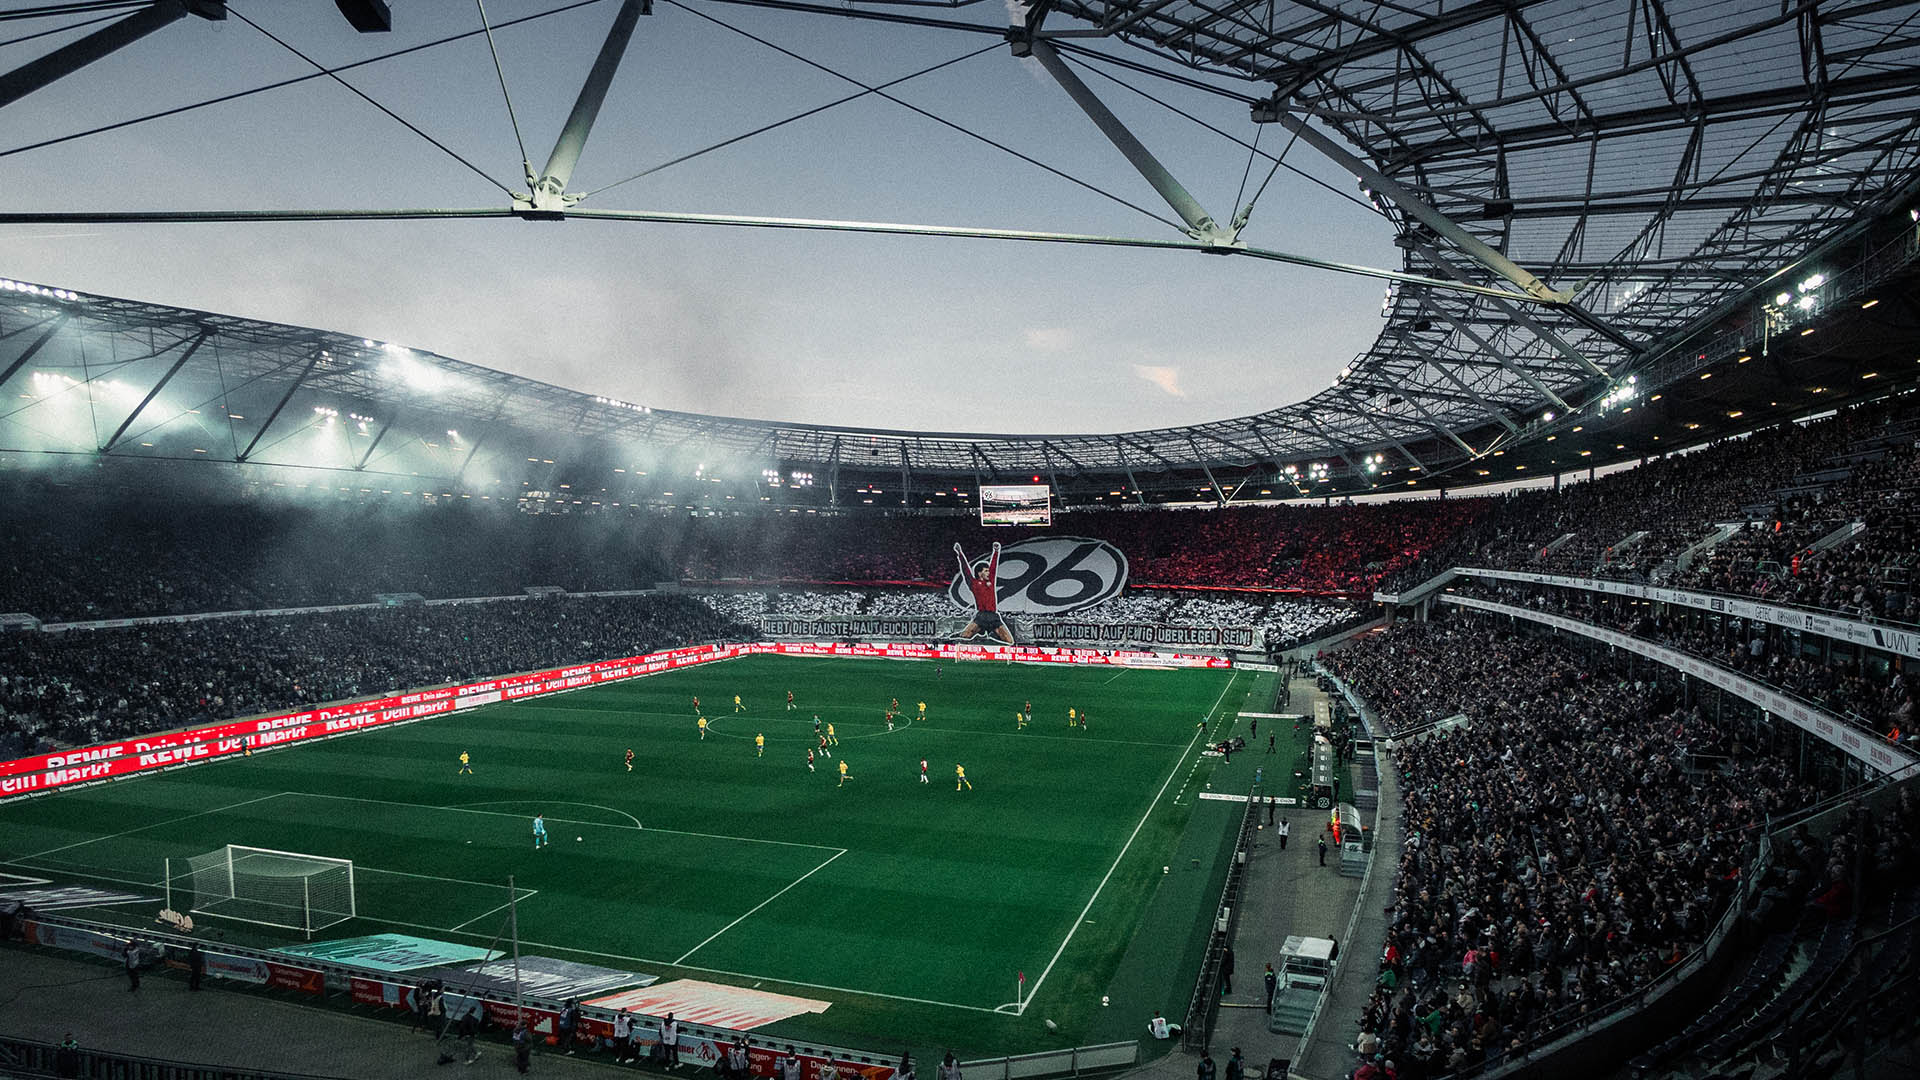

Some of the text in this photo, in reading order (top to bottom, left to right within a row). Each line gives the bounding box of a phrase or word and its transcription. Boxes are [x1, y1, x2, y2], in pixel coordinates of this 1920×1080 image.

[995, 542, 1104, 607] 96
[764, 620, 790, 634] HEBT
[853, 621, 880, 634] HAUT
[883, 622, 909, 634] EUCH
[1034, 624, 1054, 638] WIR
[1056, 624, 1099, 639] WERDEN
[1102, 625, 1124, 639] AUF
[1158, 625, 1218, 644] ÜBERLEGEN
[1886, 632, 1909, 652] UVN
[401, 694, 421, 704] REWE
[413, 700, 449, 715] Markt
[260, 727, 307, 745] Markt
[45, 761, 113, 785] Markt
[1319, 799, 1329, 807] 96
